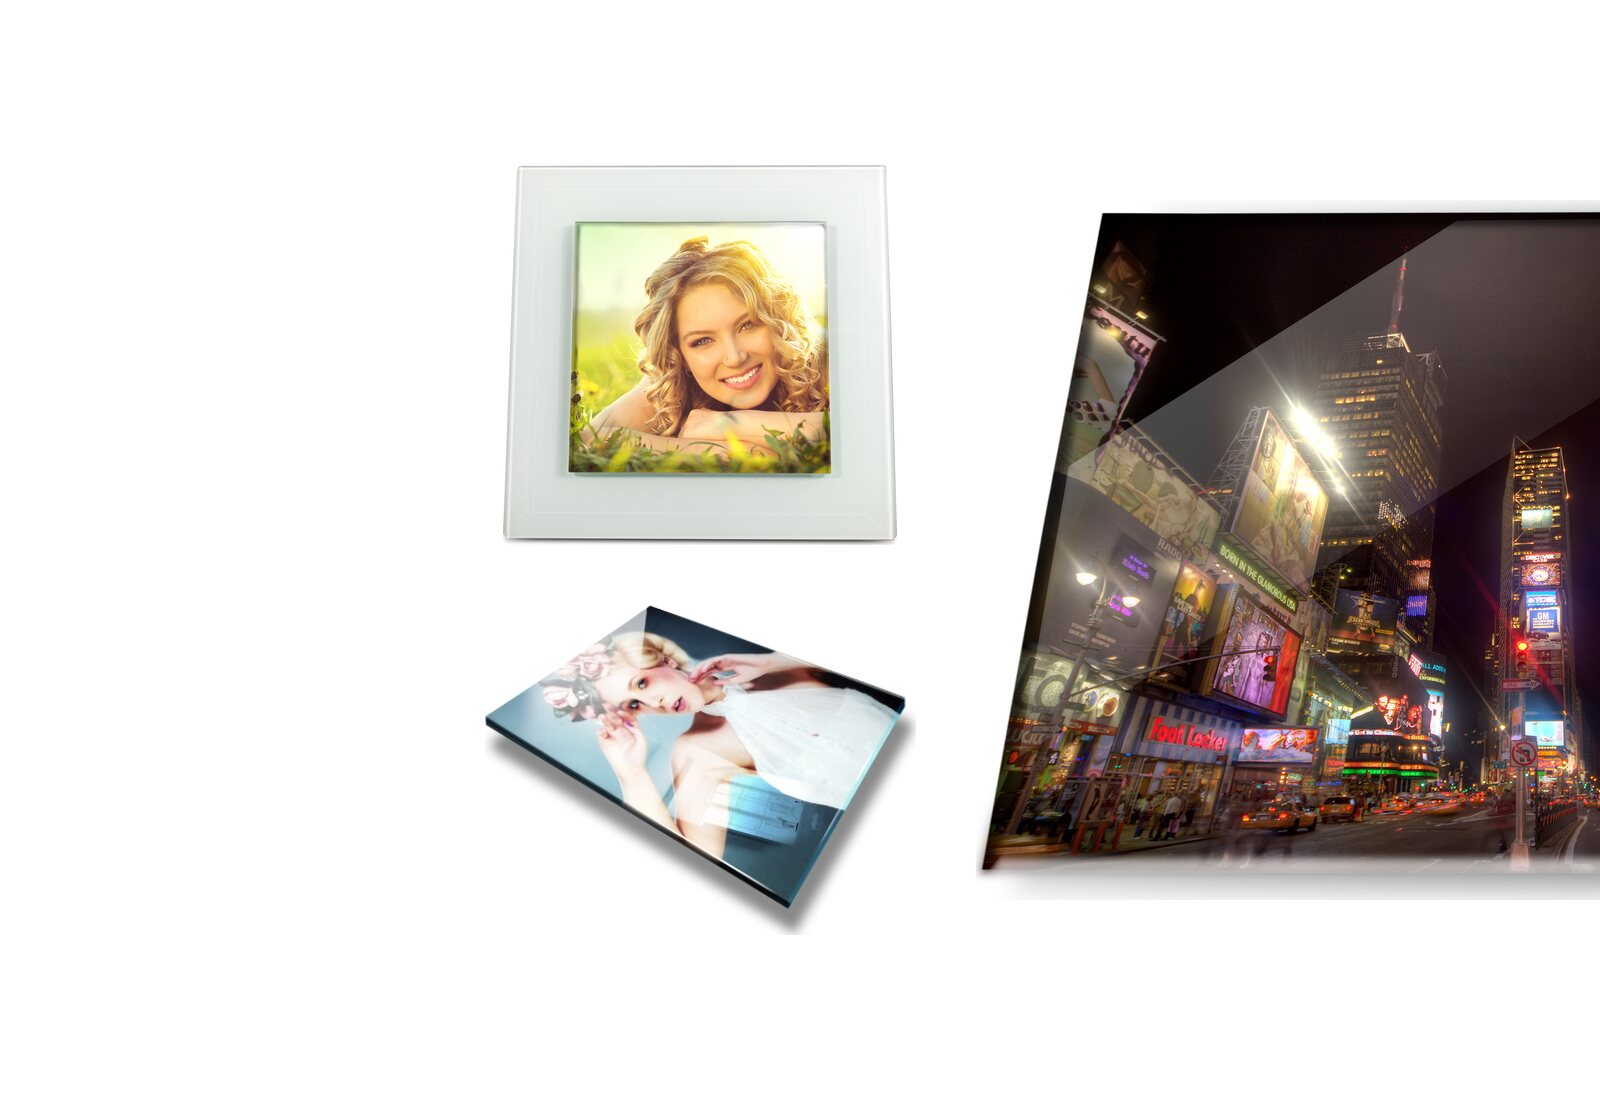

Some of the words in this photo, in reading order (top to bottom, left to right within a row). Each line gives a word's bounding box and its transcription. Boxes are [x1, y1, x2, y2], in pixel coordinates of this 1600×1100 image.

[1157, 537, 1182, 560] RADO
[1220, 545, 1240, 567] BORN
[1239, 559, 1248, 573] IN
[1246, 564, 1258, 581] THE
[1256, 575, 1288, 605] GLAMOROUS
[1286, 599, 1297, 612] USA
[1537, 611, 1550, 620] GM
[1149, 715, 1185, 745] Foot
[1186, 724, 1228, 753] Locker
